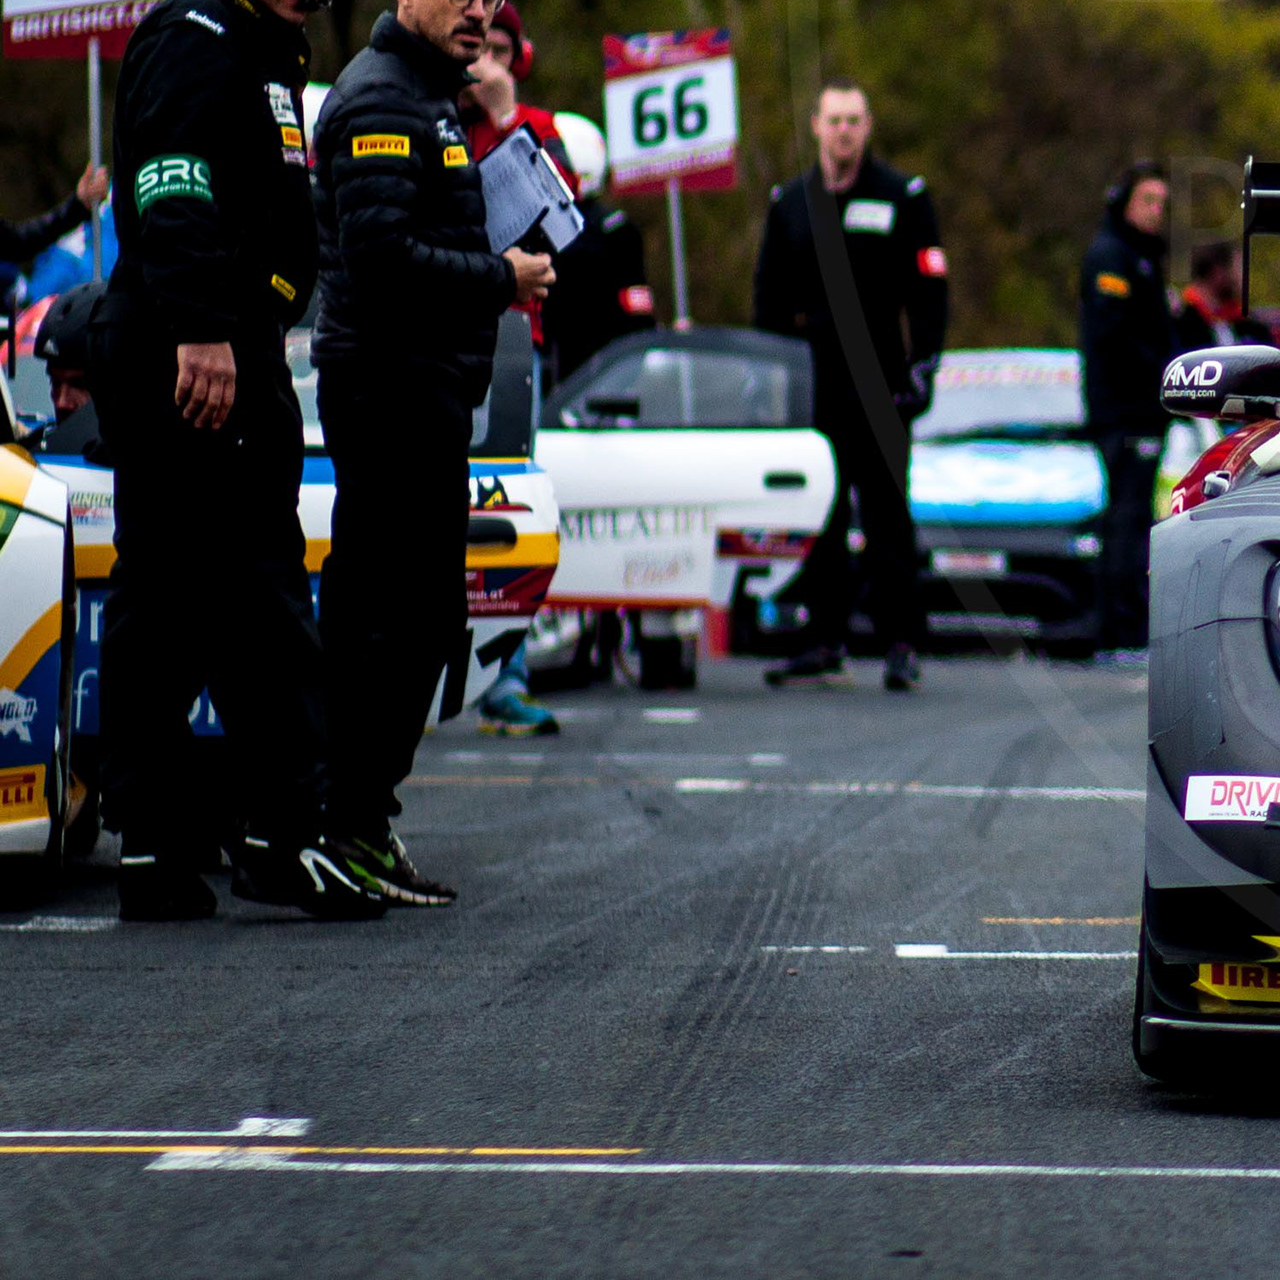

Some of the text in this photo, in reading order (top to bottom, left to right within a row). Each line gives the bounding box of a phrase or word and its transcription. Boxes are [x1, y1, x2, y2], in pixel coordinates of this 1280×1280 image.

[10, 0, 163, 43] BRITISHGT.C
[633, 76, 709, 149] 66
[1163, 360, 1223, 387] AMD
